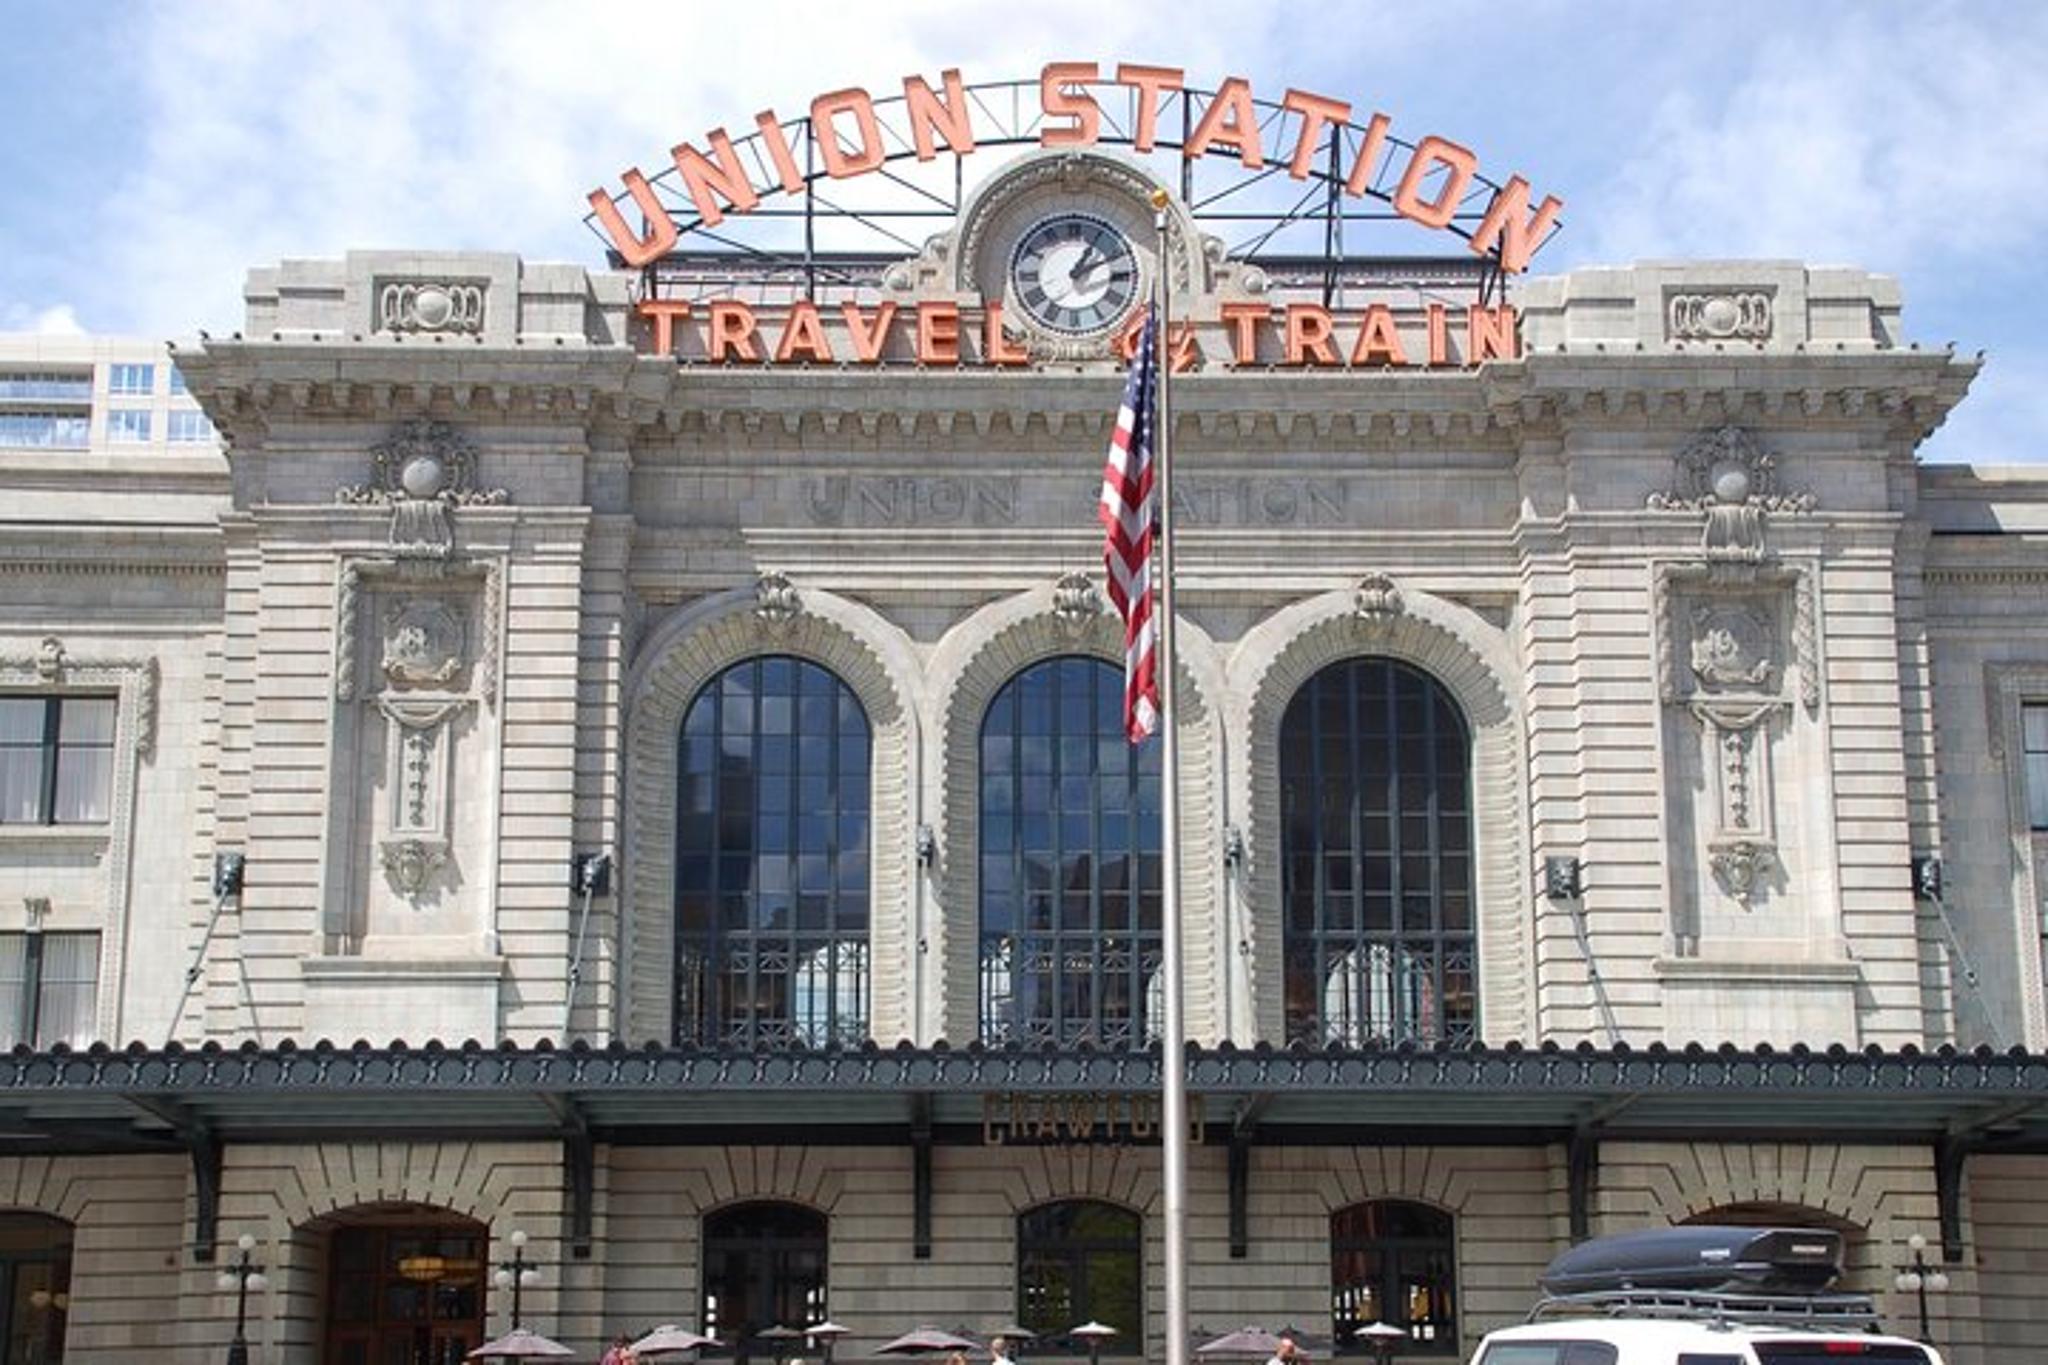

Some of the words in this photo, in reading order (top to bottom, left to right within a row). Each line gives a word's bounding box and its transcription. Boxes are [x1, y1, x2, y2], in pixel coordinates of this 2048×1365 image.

[587, 68, 976, 268] UNION
[1040, 62, 1563, 274] STATION
[635, 299, 1031, 366] TRAVEL
[1220, 303, 1520, 366] TRAIN
[804, 476, 1022, 525] UNION
[1091, 476, 1349, 525] ATION
[983, 1090, 1205, 1144] CRAWFOD
